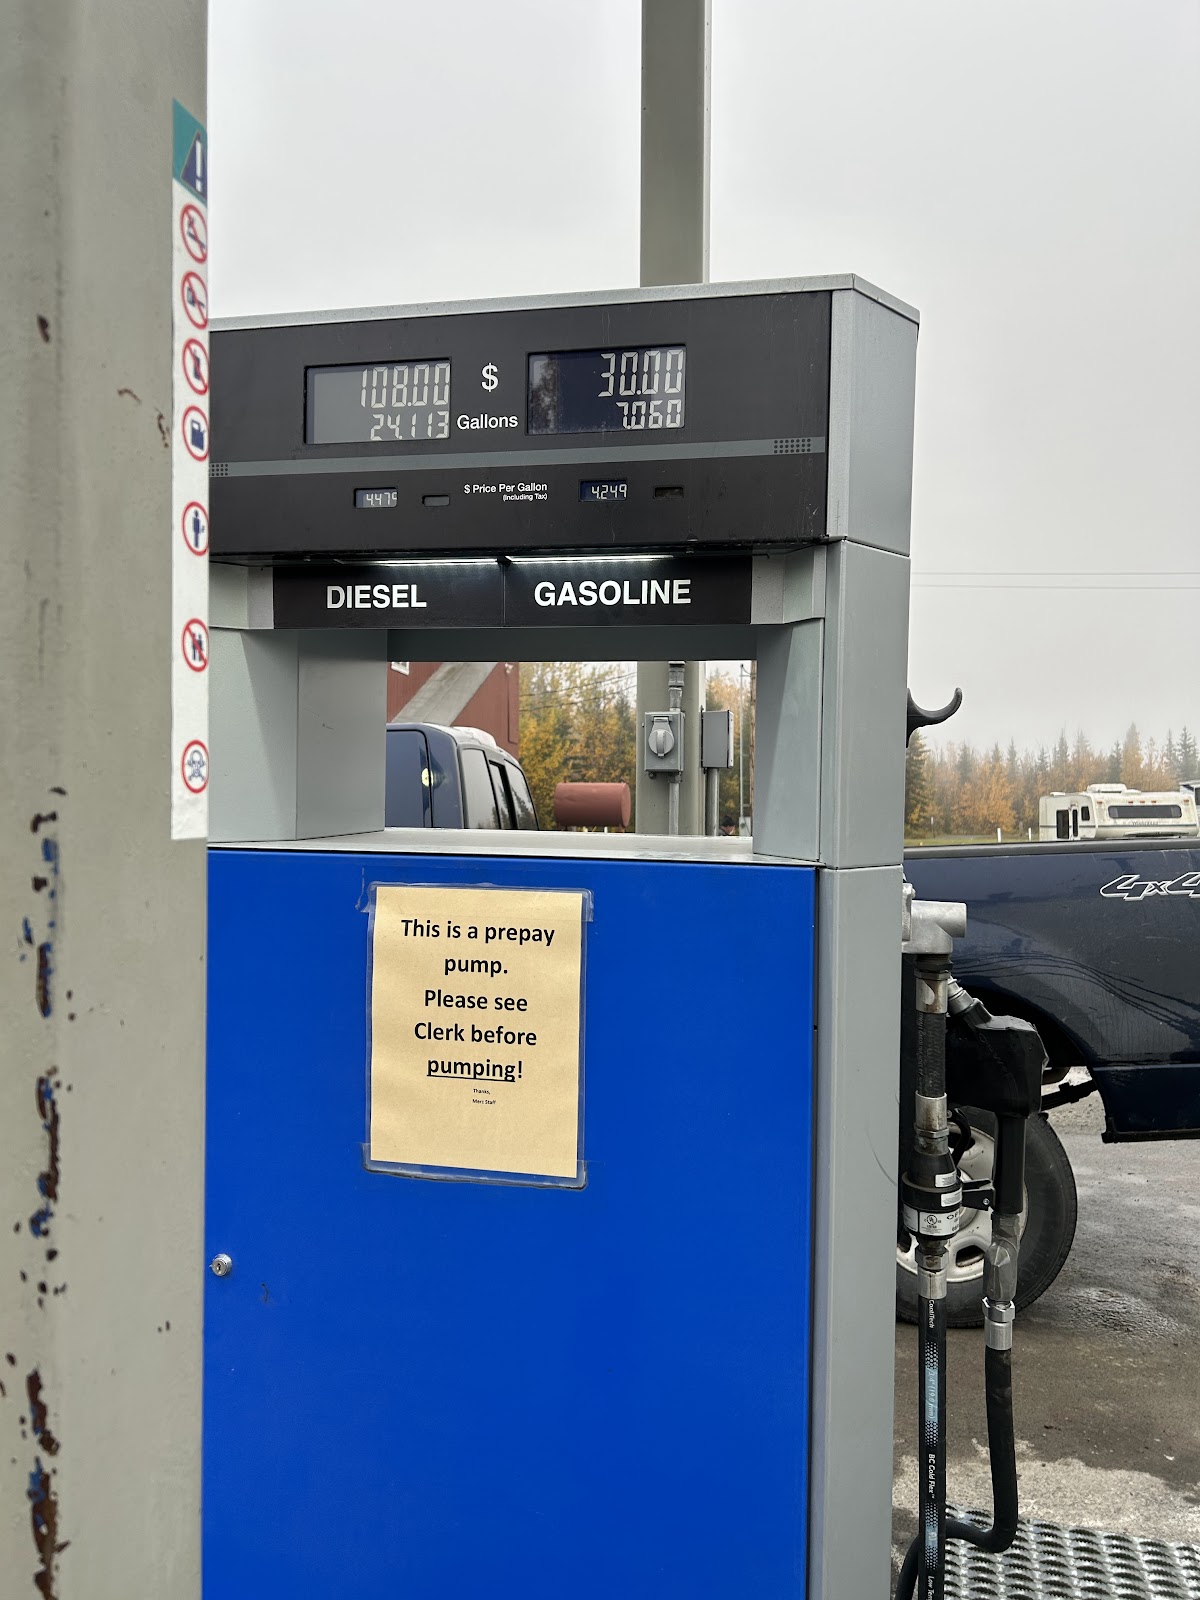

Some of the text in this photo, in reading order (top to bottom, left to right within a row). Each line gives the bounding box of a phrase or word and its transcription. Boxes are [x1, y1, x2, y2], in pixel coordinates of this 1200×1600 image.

[481, 362, 499, 392] $
[599, 349, 684, 397] 30.00
[360, 363, 450, 409] 108.00
[370, 411, 450, 441] 24.113
[456, 413, 519, 431] Gallons
[615, 399, 682, 429] 7.060
[472, 484, 497, 493] Price
[498, 483, 516, 493] Per
[517, 482, 548, 492] Gallon
[535, 492, 548, 500] Tax)
[591, 483, 628, 500] 4.249
[326, 584, 427, 609] DIESEL
[534, 579, 692, 607] GASOLINE
[401, 919, 555, 947] This is a prepay
[444, 957, 508, 977] pump.
[424, 989, 528, 1012] Please see
[414, 1022, 537, 1046] Clerk before
[427, 1058, 523, 1082] pumping!
[928, 1464, 936, 1480] Cold
[927, 1575, 935, 1589] Low
